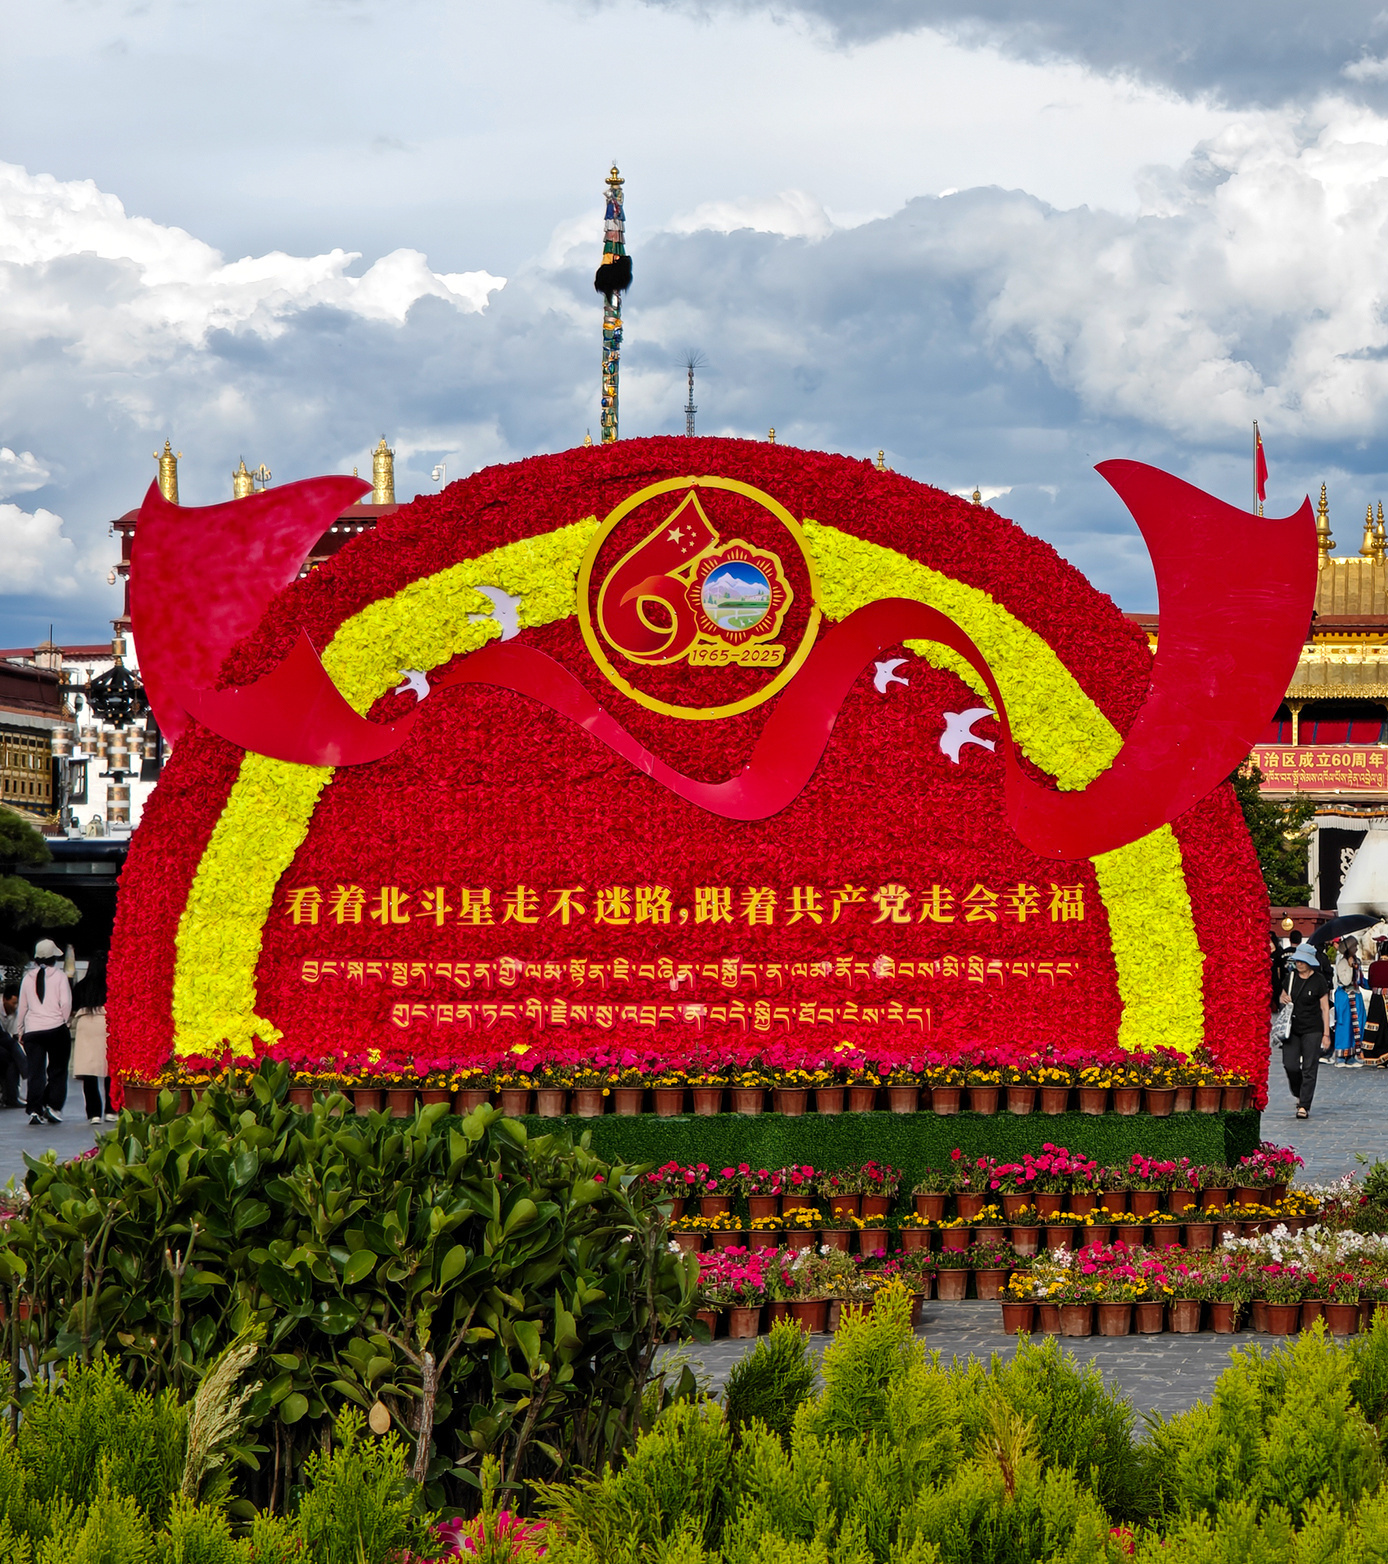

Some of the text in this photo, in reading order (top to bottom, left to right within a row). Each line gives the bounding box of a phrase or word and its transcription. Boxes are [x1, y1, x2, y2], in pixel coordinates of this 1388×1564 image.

[692, 649, 781, 662] 1965-2025
[1249, 752, 1385, 768] 自治区成立60周年
